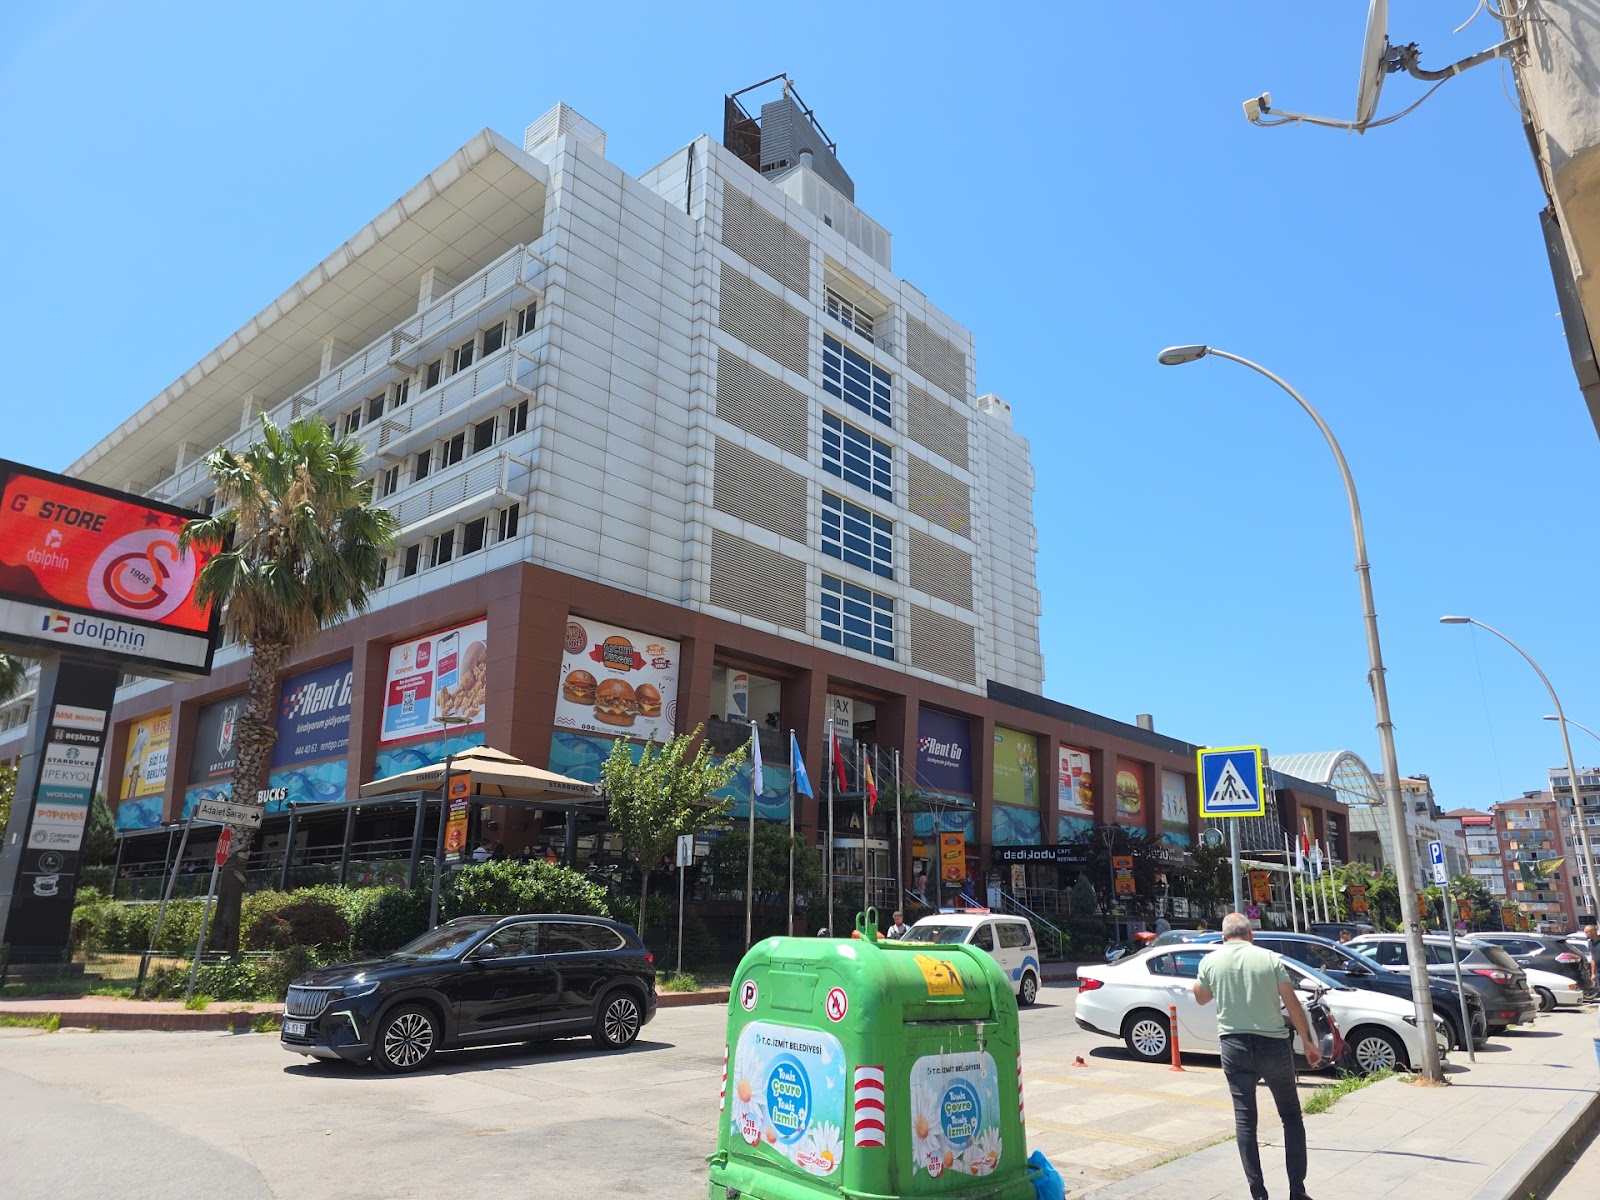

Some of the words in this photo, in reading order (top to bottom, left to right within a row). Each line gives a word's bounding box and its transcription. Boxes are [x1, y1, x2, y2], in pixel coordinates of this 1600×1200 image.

[26, 547, 69, 571] dolphin
[129, 567, 151, 585] 1905
[73, 619, 145, 648] dolphin
[106, 641, 144, 652] center
[603, 653, 634, 665] BURGER
[300, 678, 340, 716] Rent
[55, 711, 73, 720] MM
[74, 714, 103, 724] MIGROS
[65, 733, 100, 744] BEŞİKTAŞ
[928, 737, 951, 758] Rent
[950, 743, 962, 760] Go
[47, 757, 95, 767] STARBUCKS
[548, 781, 588, 793] STARBUCKS
[46, 791, 84, 799] watsons
[202, 805, 226, 816] Adalet
[226, 808, 248, 821] Sarayı
[850, 812, 860, 829] A
[1431, 844, 1440, 864] P
[745, 985, 754, 1005] P
[772, 1038, 788, 1049] İZMİT
[789, 1040, 822, 1055] BELEDİYESİ
[778, 1068, 796, 1081] Temiz
[772, 1080, 802, 1098] Çevre
[777, 1097, 795, 1111] Temiz
[945, 1101, 972, 1116] Çevre
[746, 1119, 755, 1128] 318
[743, 1127, 750, 1135] 00
[751, 1128, 757, 1136] 77
